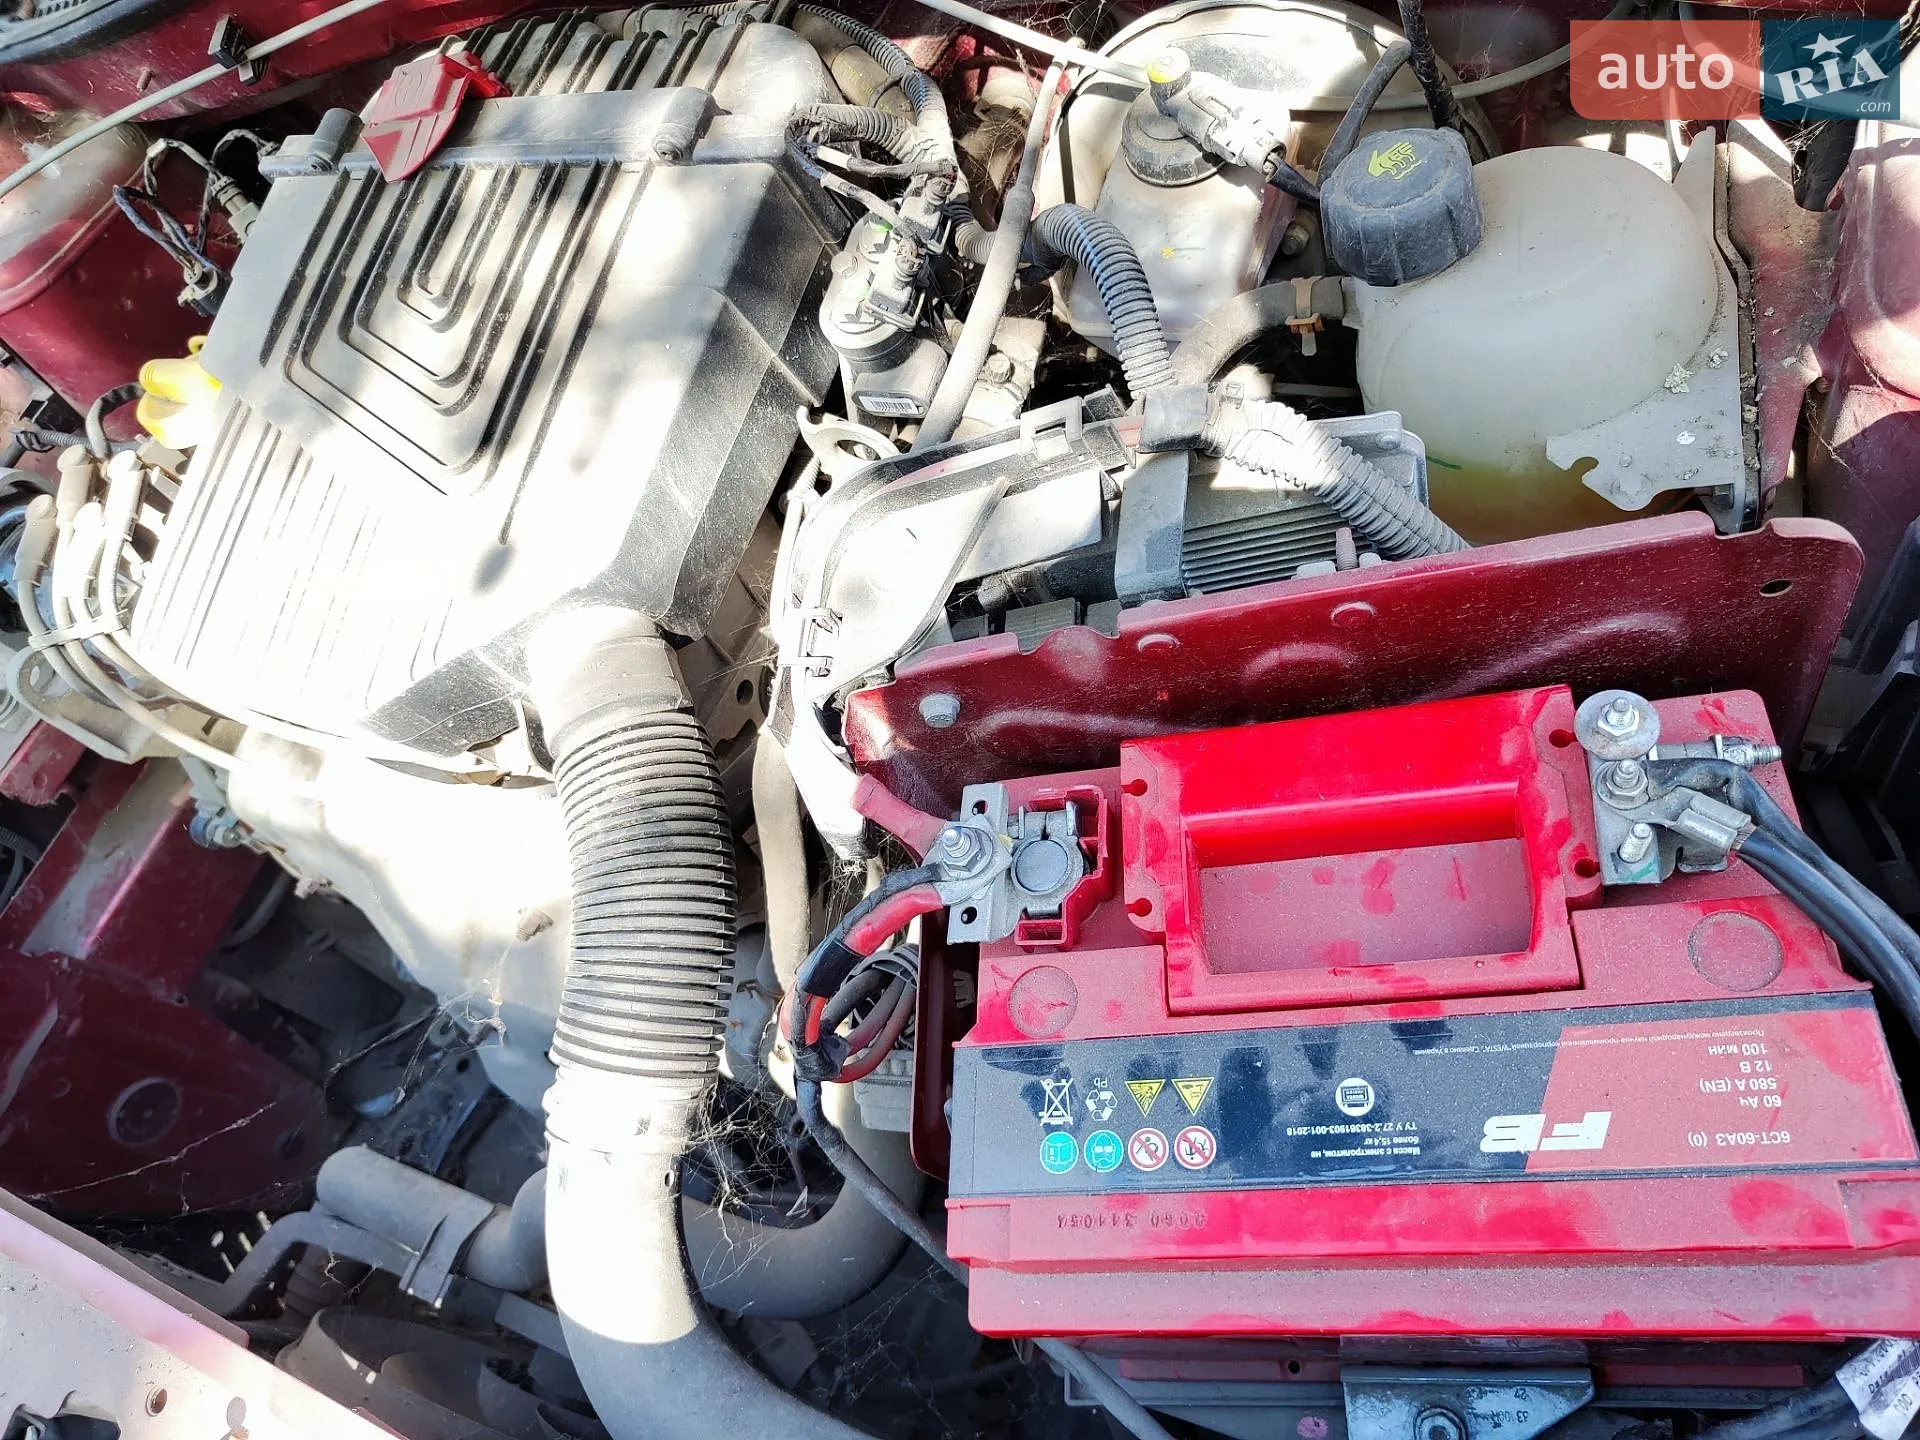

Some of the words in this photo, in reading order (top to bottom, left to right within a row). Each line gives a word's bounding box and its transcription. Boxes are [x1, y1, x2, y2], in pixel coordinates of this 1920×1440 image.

[1708, 1044, 1737, 1055] мин
[1742, 1043, 1767, 1055] 100
[1755, 1060, 1772, 1072] 12
[1094, 1077, 1107, 1087] Pb
[1700, 1077, 1731, 1093] (EN)
[1750, 1077, 1777, 1090] 580
[1739, 1095, 1759, 1108] Ач
[1763, 1094, 1782, 1107] 60
[1480, 1111, 1612, 1152] FB
[1393, 1136, 1420, 1146] более
[1393, 1147, 1421, 1156] Масса
